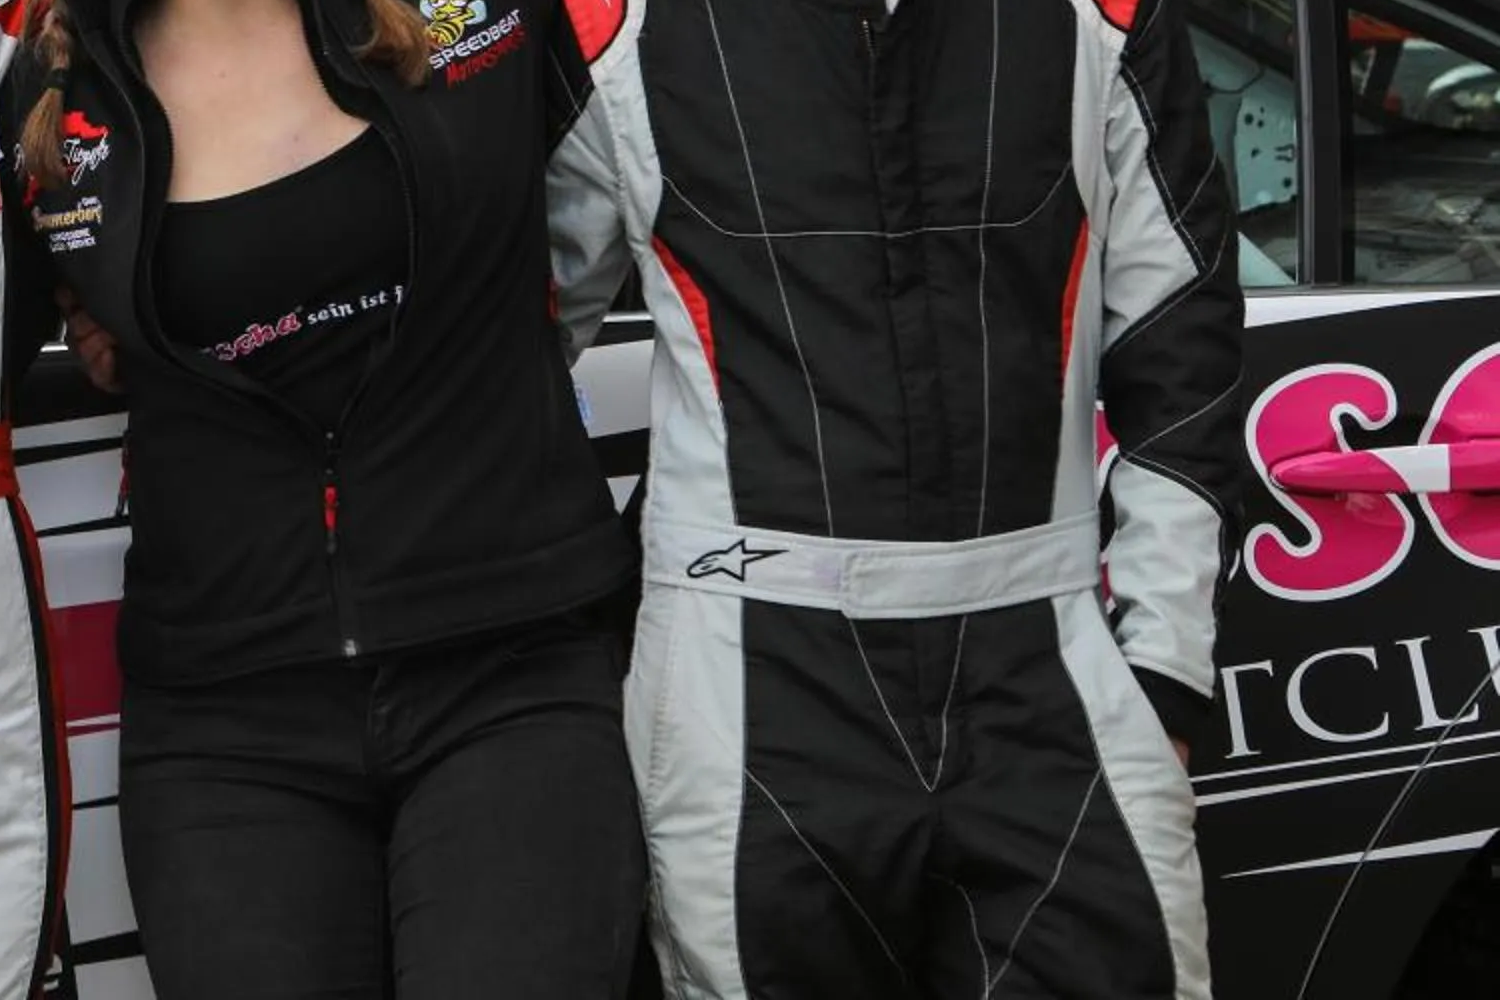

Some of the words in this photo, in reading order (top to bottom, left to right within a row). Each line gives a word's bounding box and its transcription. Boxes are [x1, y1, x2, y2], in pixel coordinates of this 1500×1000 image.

[428, 8, 520, 70] SPEEDBEAT
[308, 303, 354, 325] sein
[360, 291, 387, 310] ist
